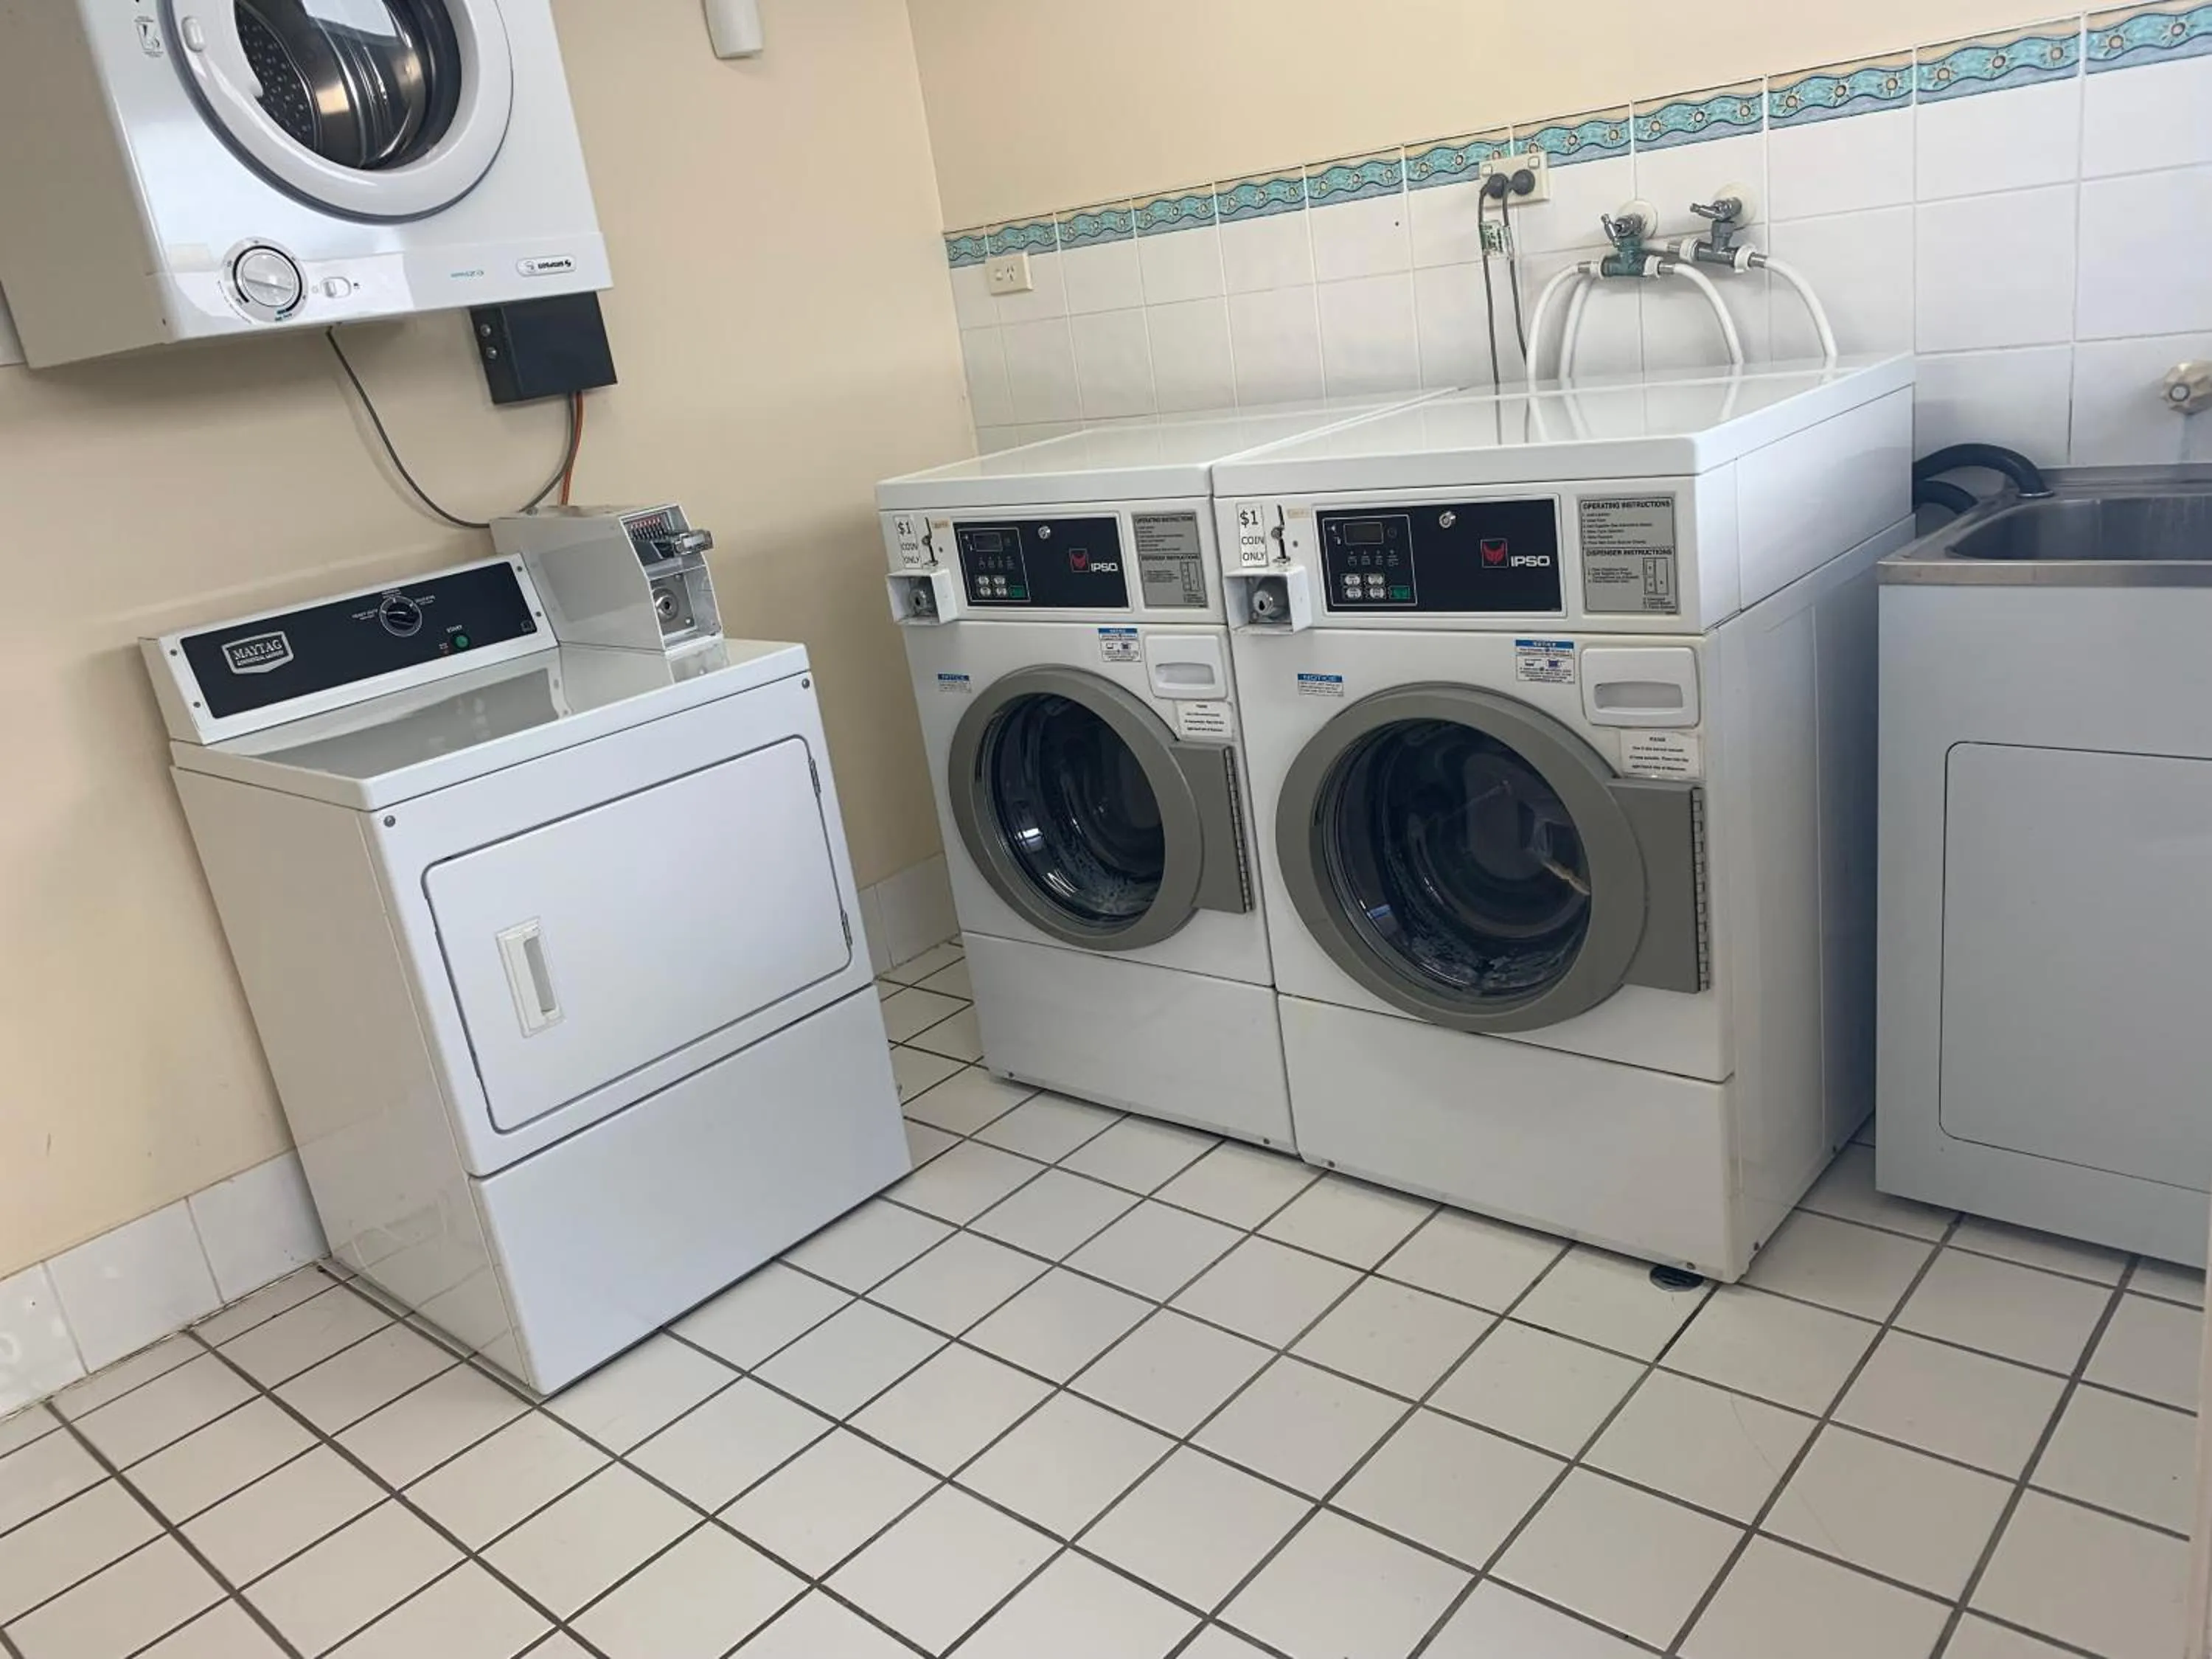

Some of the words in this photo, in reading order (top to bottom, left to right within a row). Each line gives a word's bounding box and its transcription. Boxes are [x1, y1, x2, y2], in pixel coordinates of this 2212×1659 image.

[1239, 509, 1258, 528] $1
[897, 521, 911, 535] $1
[1241, 536, 1265, 545] COIN
[1242, 552, 1265, 561] ONLY
[1510, 555, 1551, 567] IPSO
[1091, 563, 1118, 572] IPSO
[232, 639, 282, 660] MAYTAG
